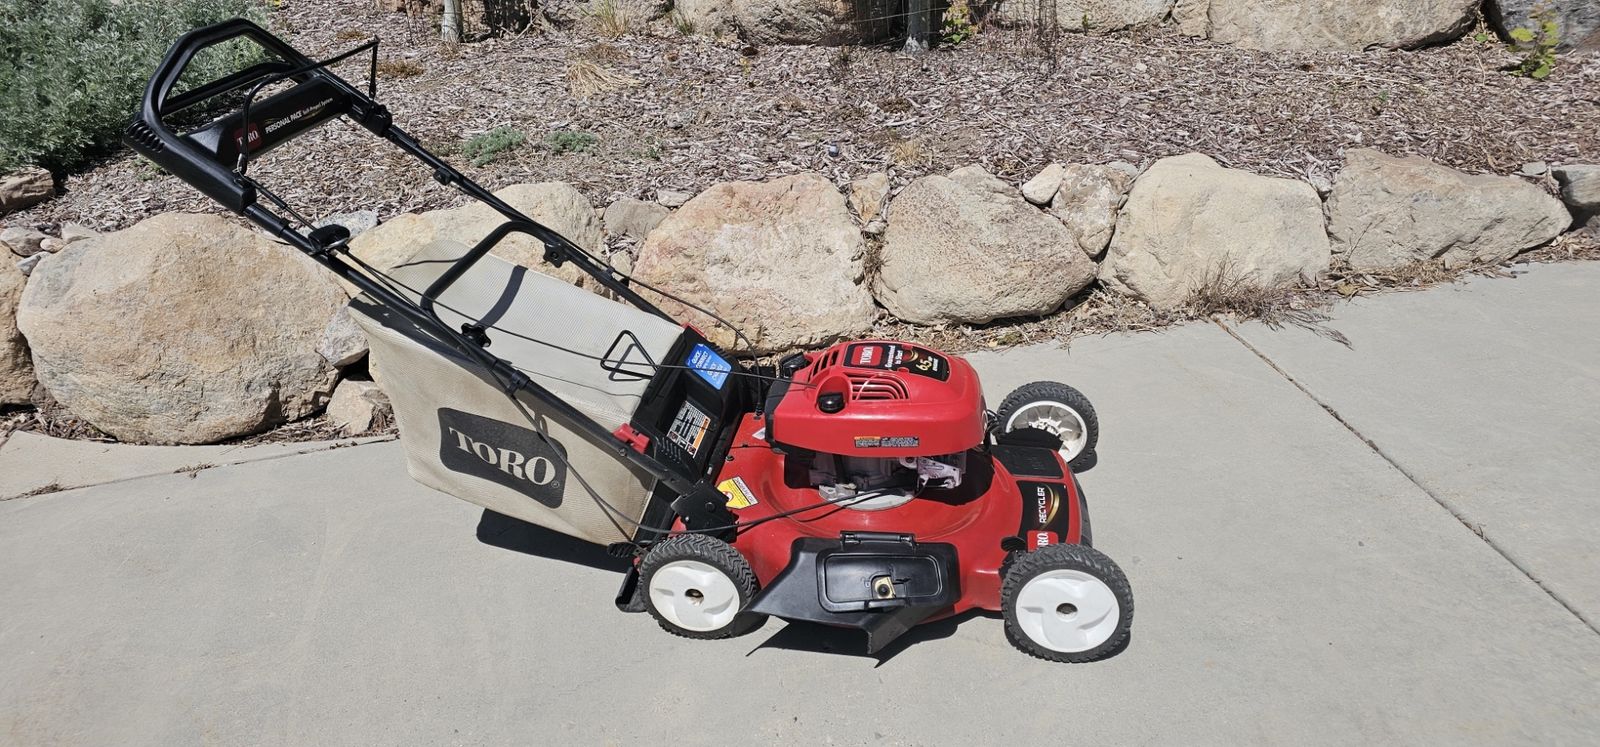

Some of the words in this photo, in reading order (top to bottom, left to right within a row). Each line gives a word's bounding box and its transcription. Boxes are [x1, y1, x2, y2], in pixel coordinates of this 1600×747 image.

[264, 116, 291, 134] PERSONAL
[290, 110, 303, 122] PACE
[236, 130, 260, 146] TRO
[860, 346, 874, 364] TORO
[884, 345, 896, 368] Guaranteed
[448, 426, 556, 486] TORO
[1036, 486, 1047, 524] RECYCLER
[1036, 532, 1049, 546] RO
